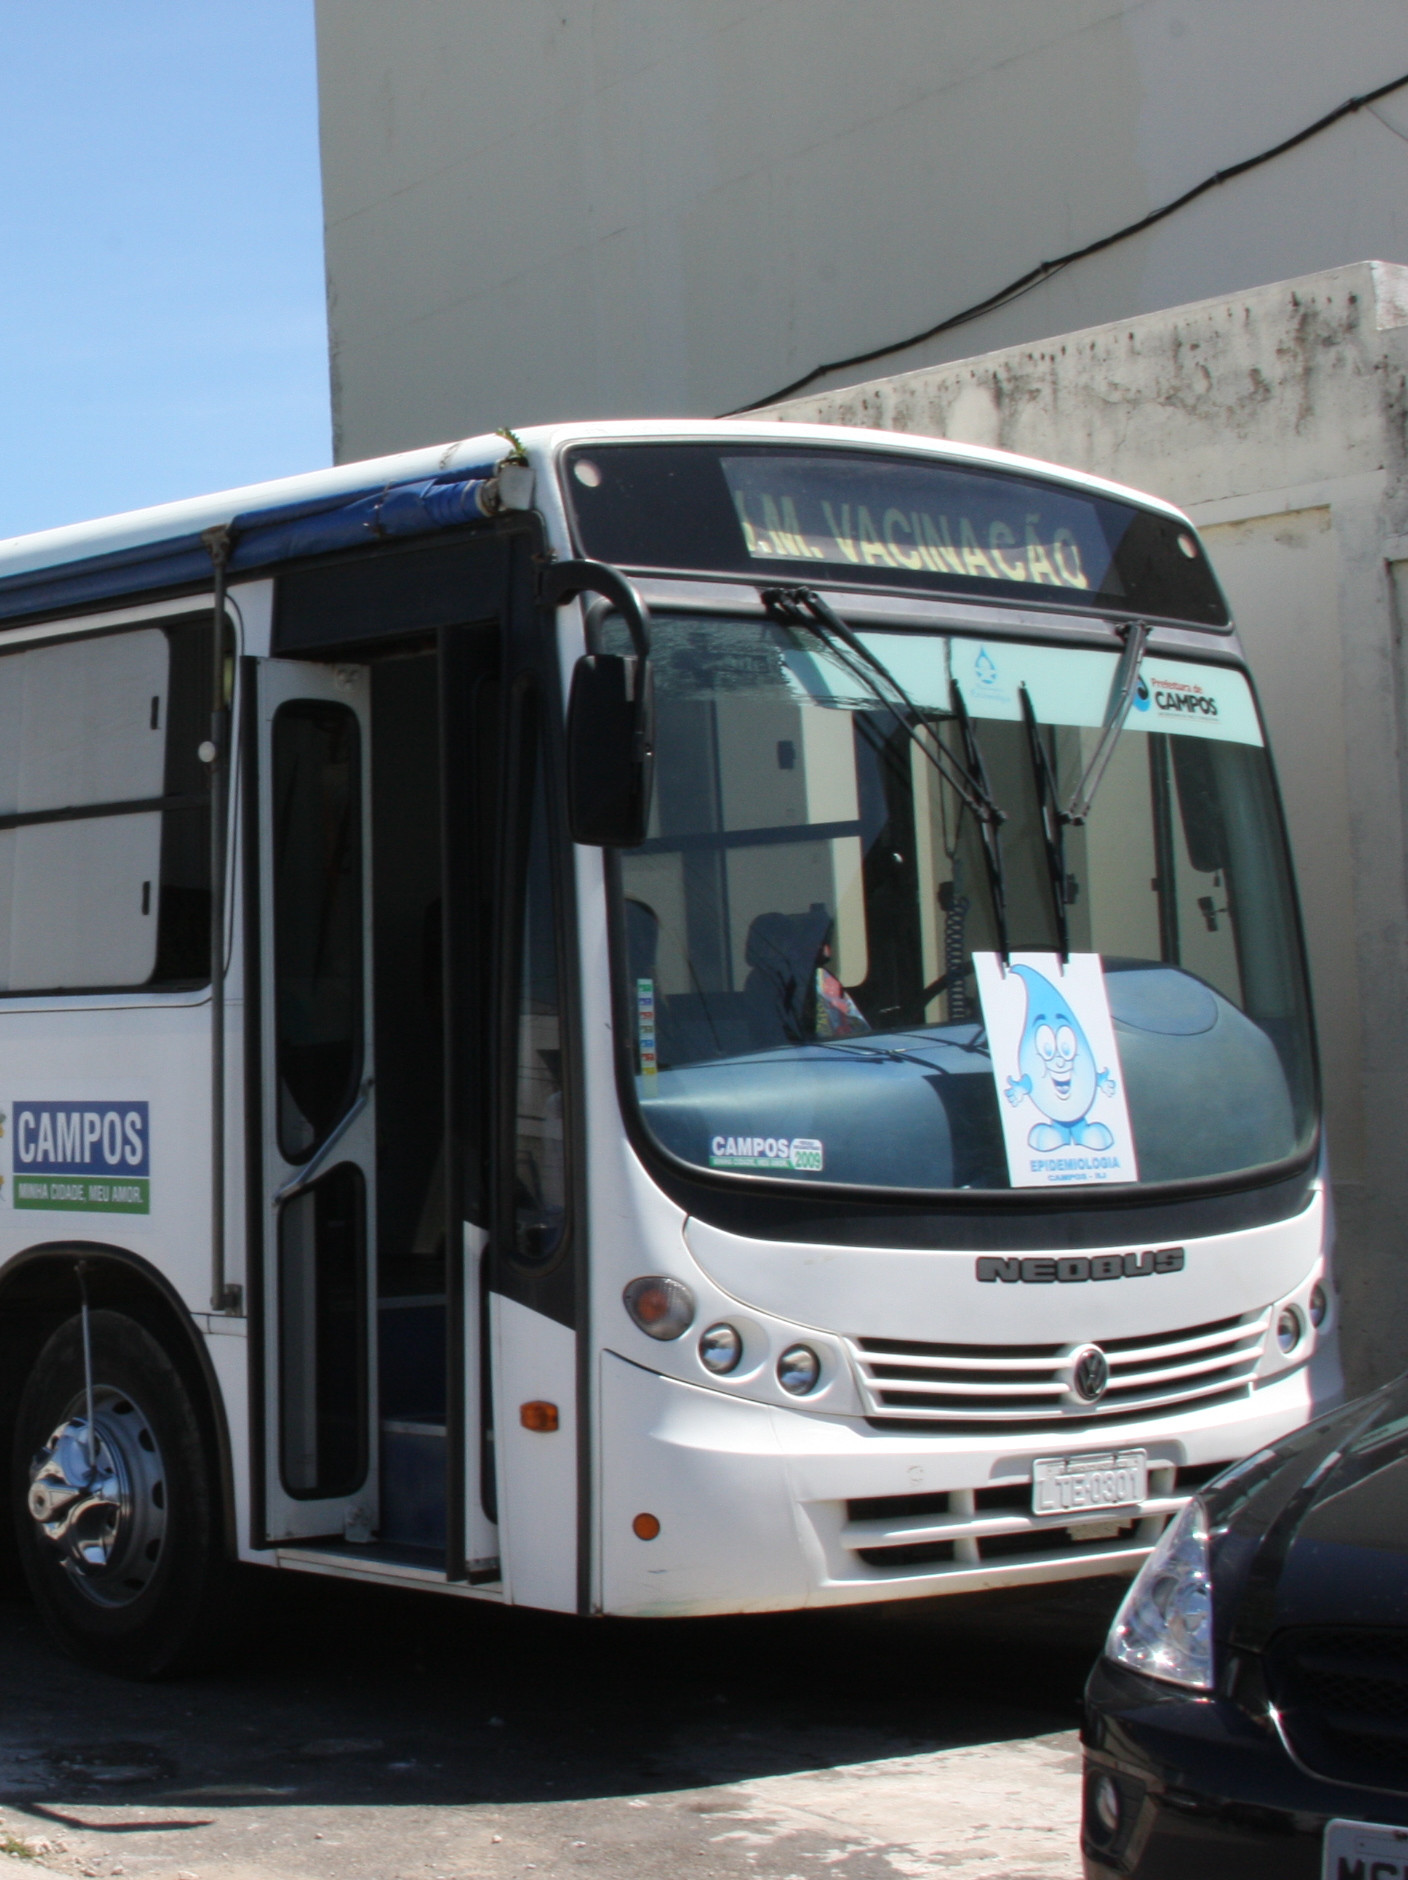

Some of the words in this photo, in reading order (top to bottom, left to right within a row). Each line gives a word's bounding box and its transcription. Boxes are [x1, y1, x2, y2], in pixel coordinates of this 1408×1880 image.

[1155, 691, 1218, 716] CAMPOS
[18, 1110, 143, 1166] CAMPOS
[711, 1136, 790, 1158] CAMPOS
[794, 1150, 821, 1169] 2009
[1031, 1157, 1121, 1172] EPIDEMIOLOGIA
[88, 1184, 111, 1202] MEU
[976, 1247, 1185, 1283] NEOBUS
